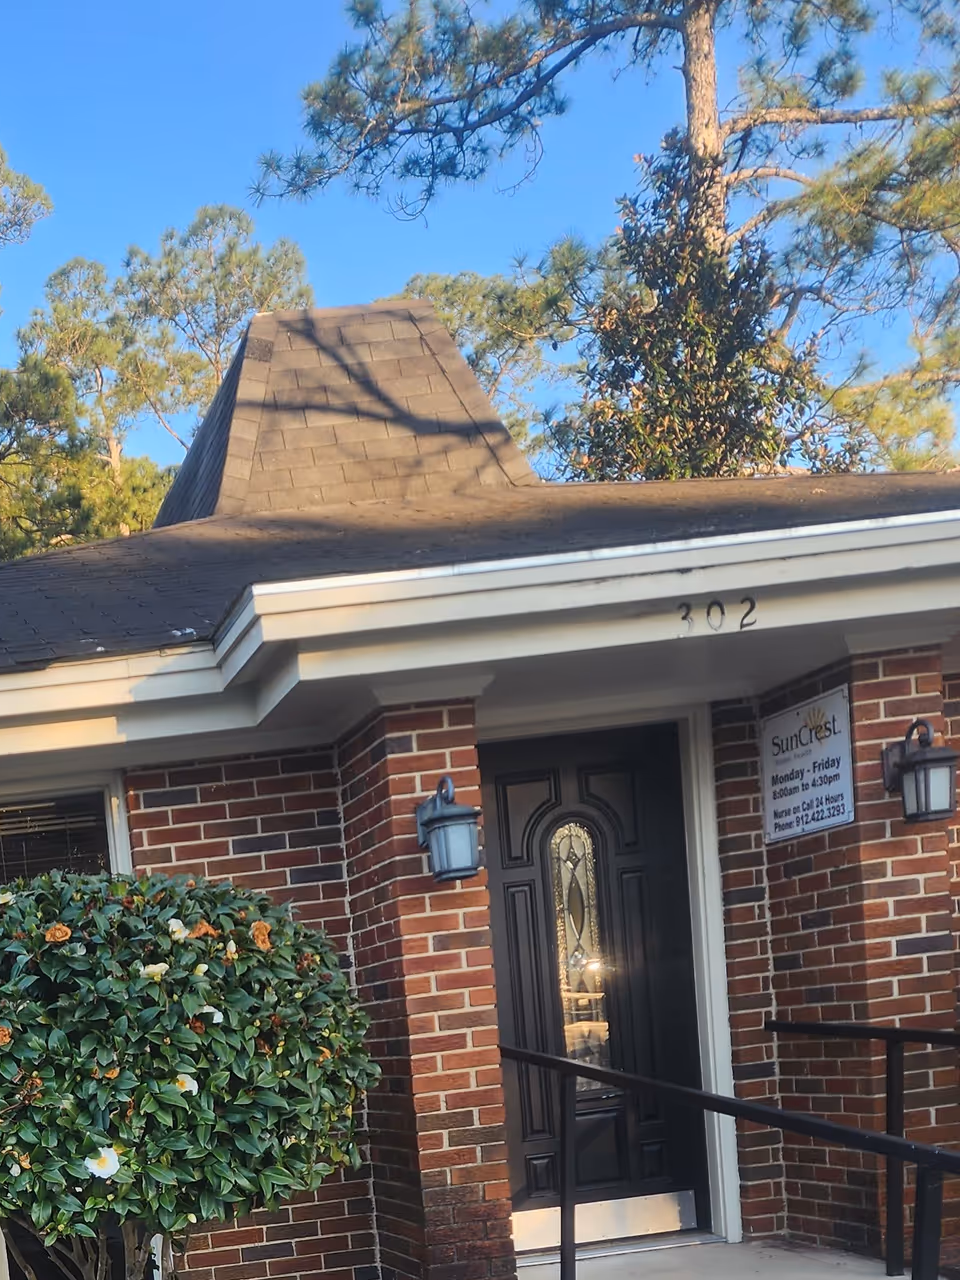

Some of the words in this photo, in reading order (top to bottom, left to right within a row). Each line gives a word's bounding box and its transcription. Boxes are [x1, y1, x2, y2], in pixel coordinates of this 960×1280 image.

[677, 597, 757, 631] 302
[772, 714, 839, 756] SunCrest
[771, 768, 805, 787] Monday
[812, 756, 841, 774] Friday
[772, 785, 800, 800] 8:00am
[802, 782, 810, 792] to
[811, 773, 840, 788] 4:30pm
[773, 808, 792, 820] Nurse
[793, 805, 801, 815] on
[801, 799, 814, 812] Call
[815, 796, 824, 809] 24
[824, 792, 844, 806] Hours
[774, 820, 795, 833] Phone:
[795, 803, 845, 827] 912.422.3293
